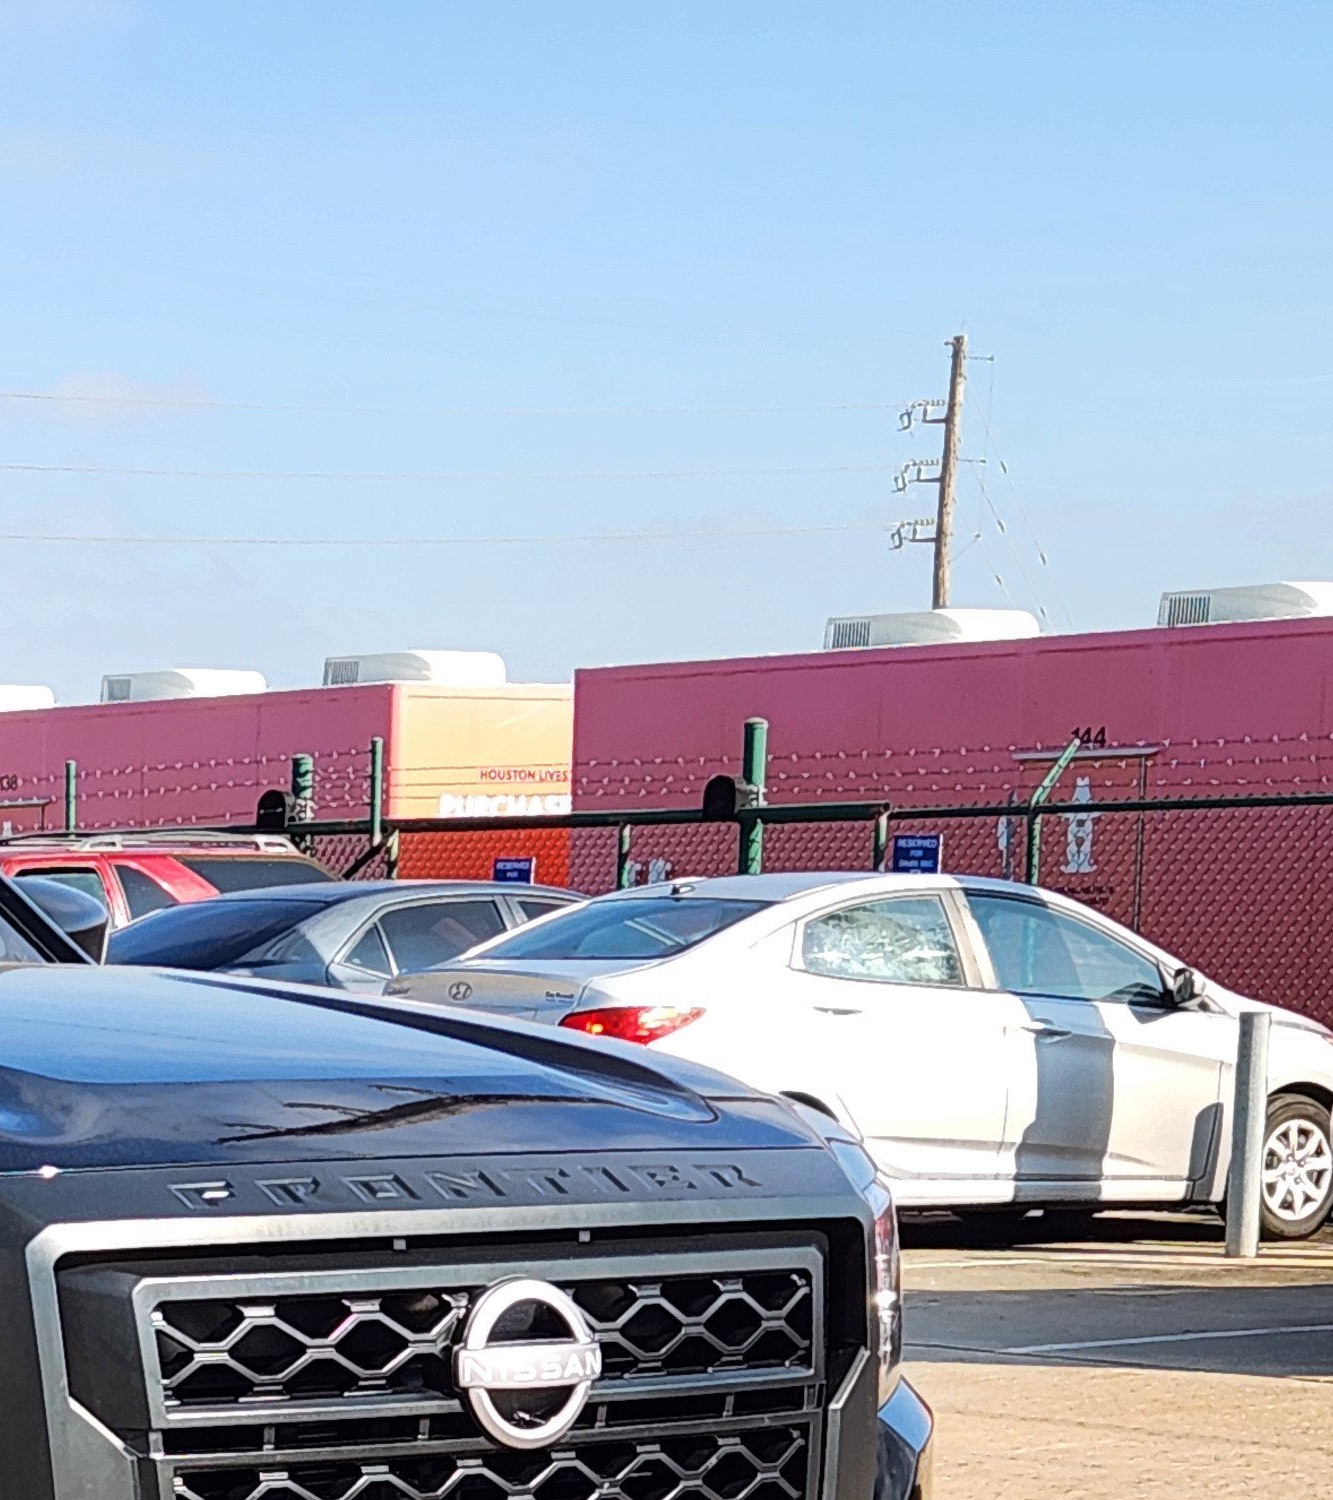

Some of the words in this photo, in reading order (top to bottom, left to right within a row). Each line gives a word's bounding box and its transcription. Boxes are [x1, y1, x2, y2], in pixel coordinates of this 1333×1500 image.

[1071, 726, 1107, 746] 144
[480, 769, 536, 781] HOUSTON
[539, 769, 568, 782] LIVES
[166, 1162, 763, 1209] FRONTIER
[463, 1350, 602, 1383] NISSAN
